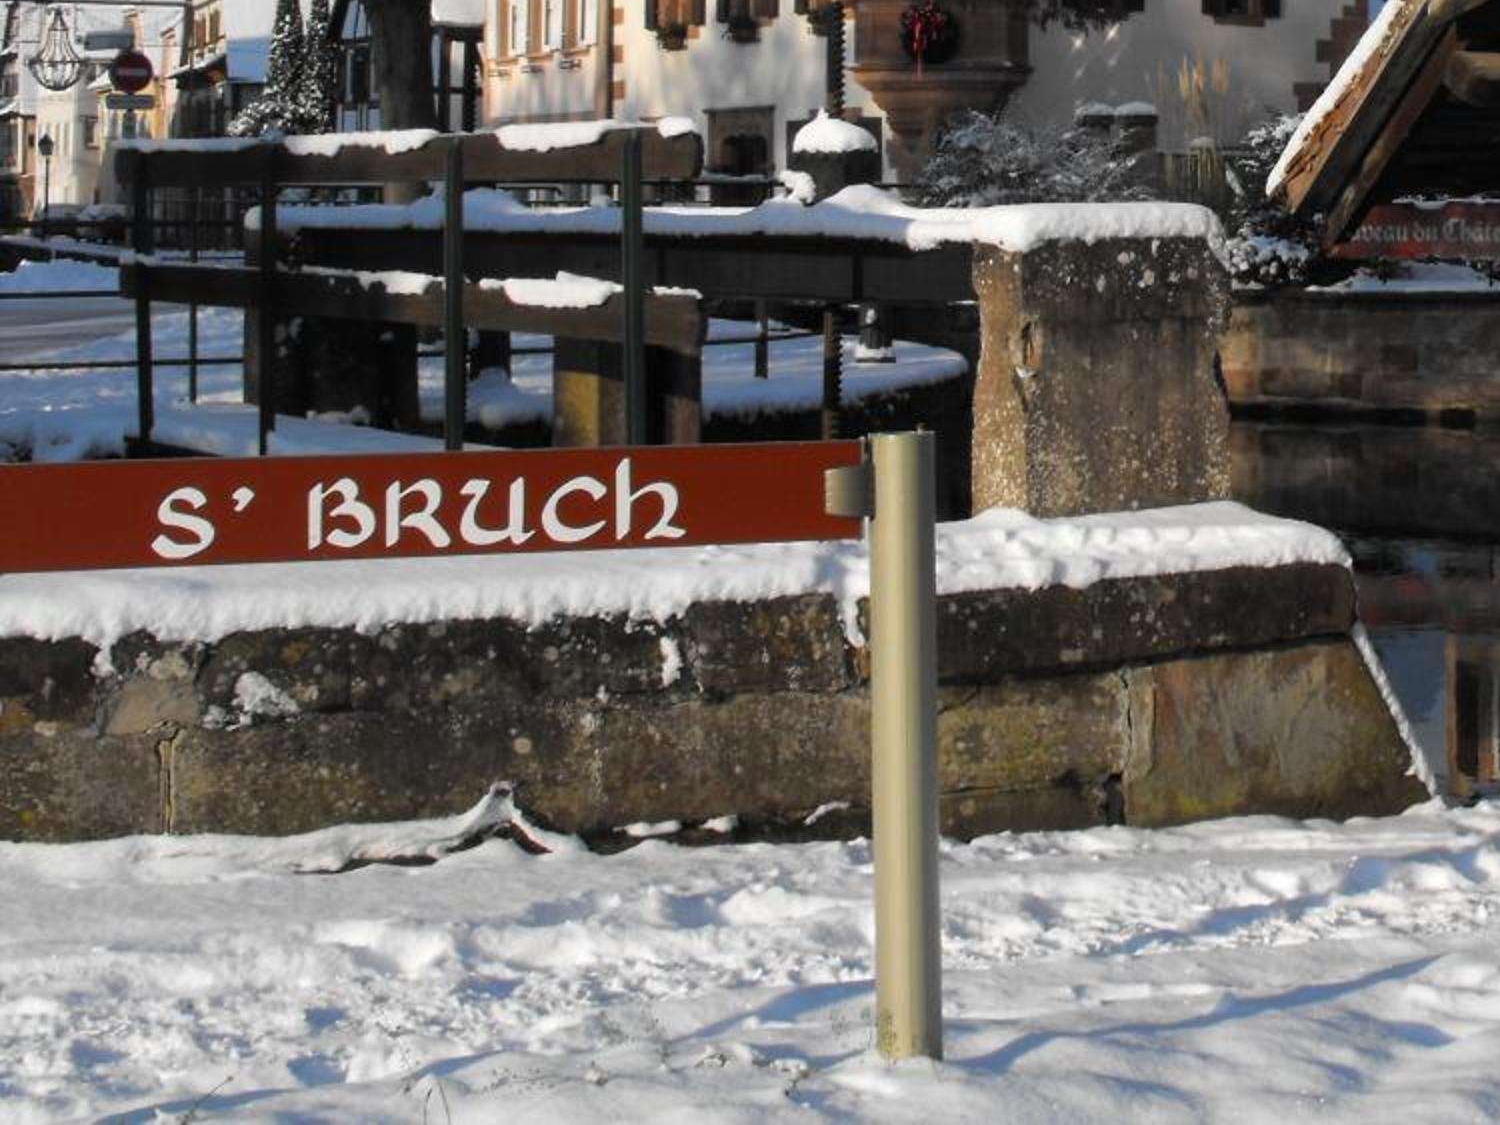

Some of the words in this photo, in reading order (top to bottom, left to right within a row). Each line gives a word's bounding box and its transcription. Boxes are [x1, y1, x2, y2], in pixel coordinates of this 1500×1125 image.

[1349, 224, 1408, 244] aveau
[1411, 220, 1438, 244] du
[151, 486, 255, 559] S'
